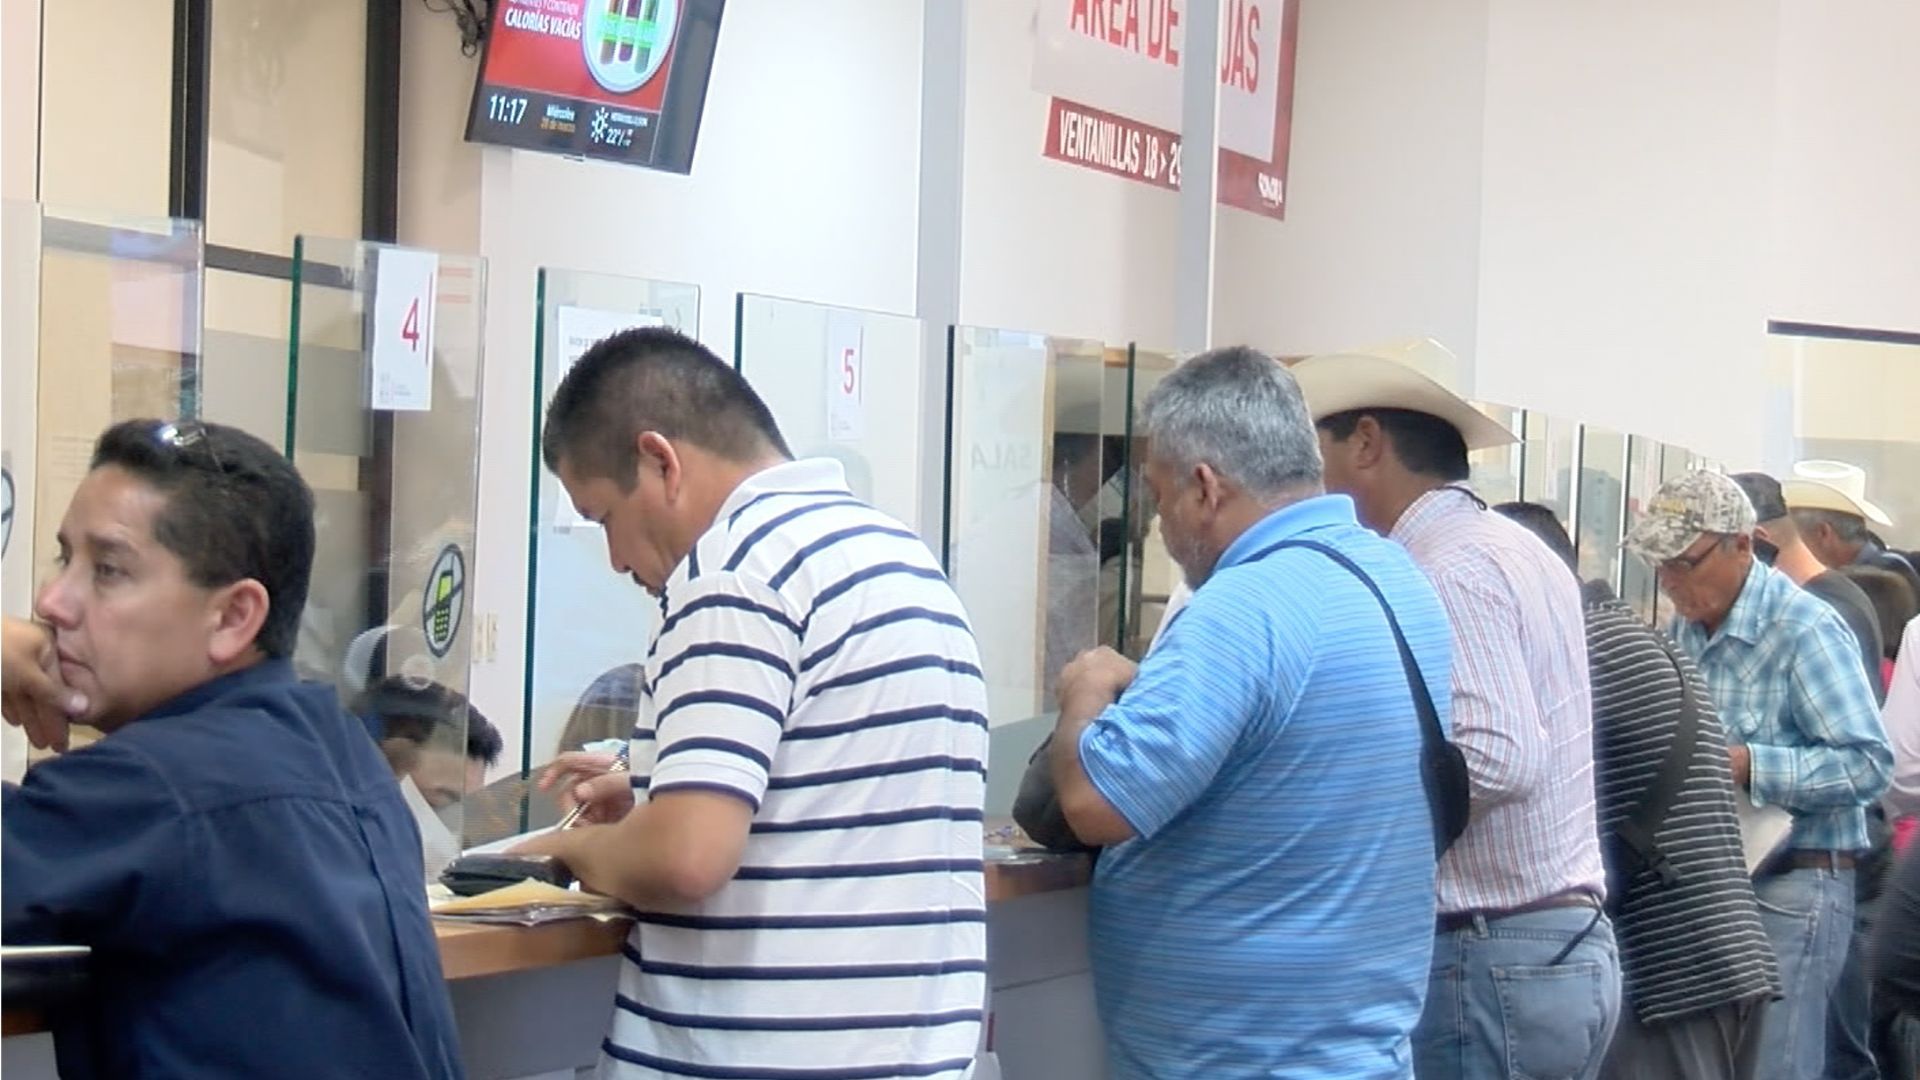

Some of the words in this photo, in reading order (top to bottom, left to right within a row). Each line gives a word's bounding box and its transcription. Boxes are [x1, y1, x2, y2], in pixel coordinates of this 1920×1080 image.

[505, 8, 550, 34] CALORÍAS
[549, 16, 582, 40] VACÍAS
[1146, 0, 1179, 66] DE
[1221, 0, 1260, 94] JAS
[489, 94, 528, 124] 11:17
[1060, 109, 1140, 174] VENTANILLAS
[1143, 134, 1159, 179] 18
[402, 297, 420, 351] 4
[843, 348, 855, 395] 5
